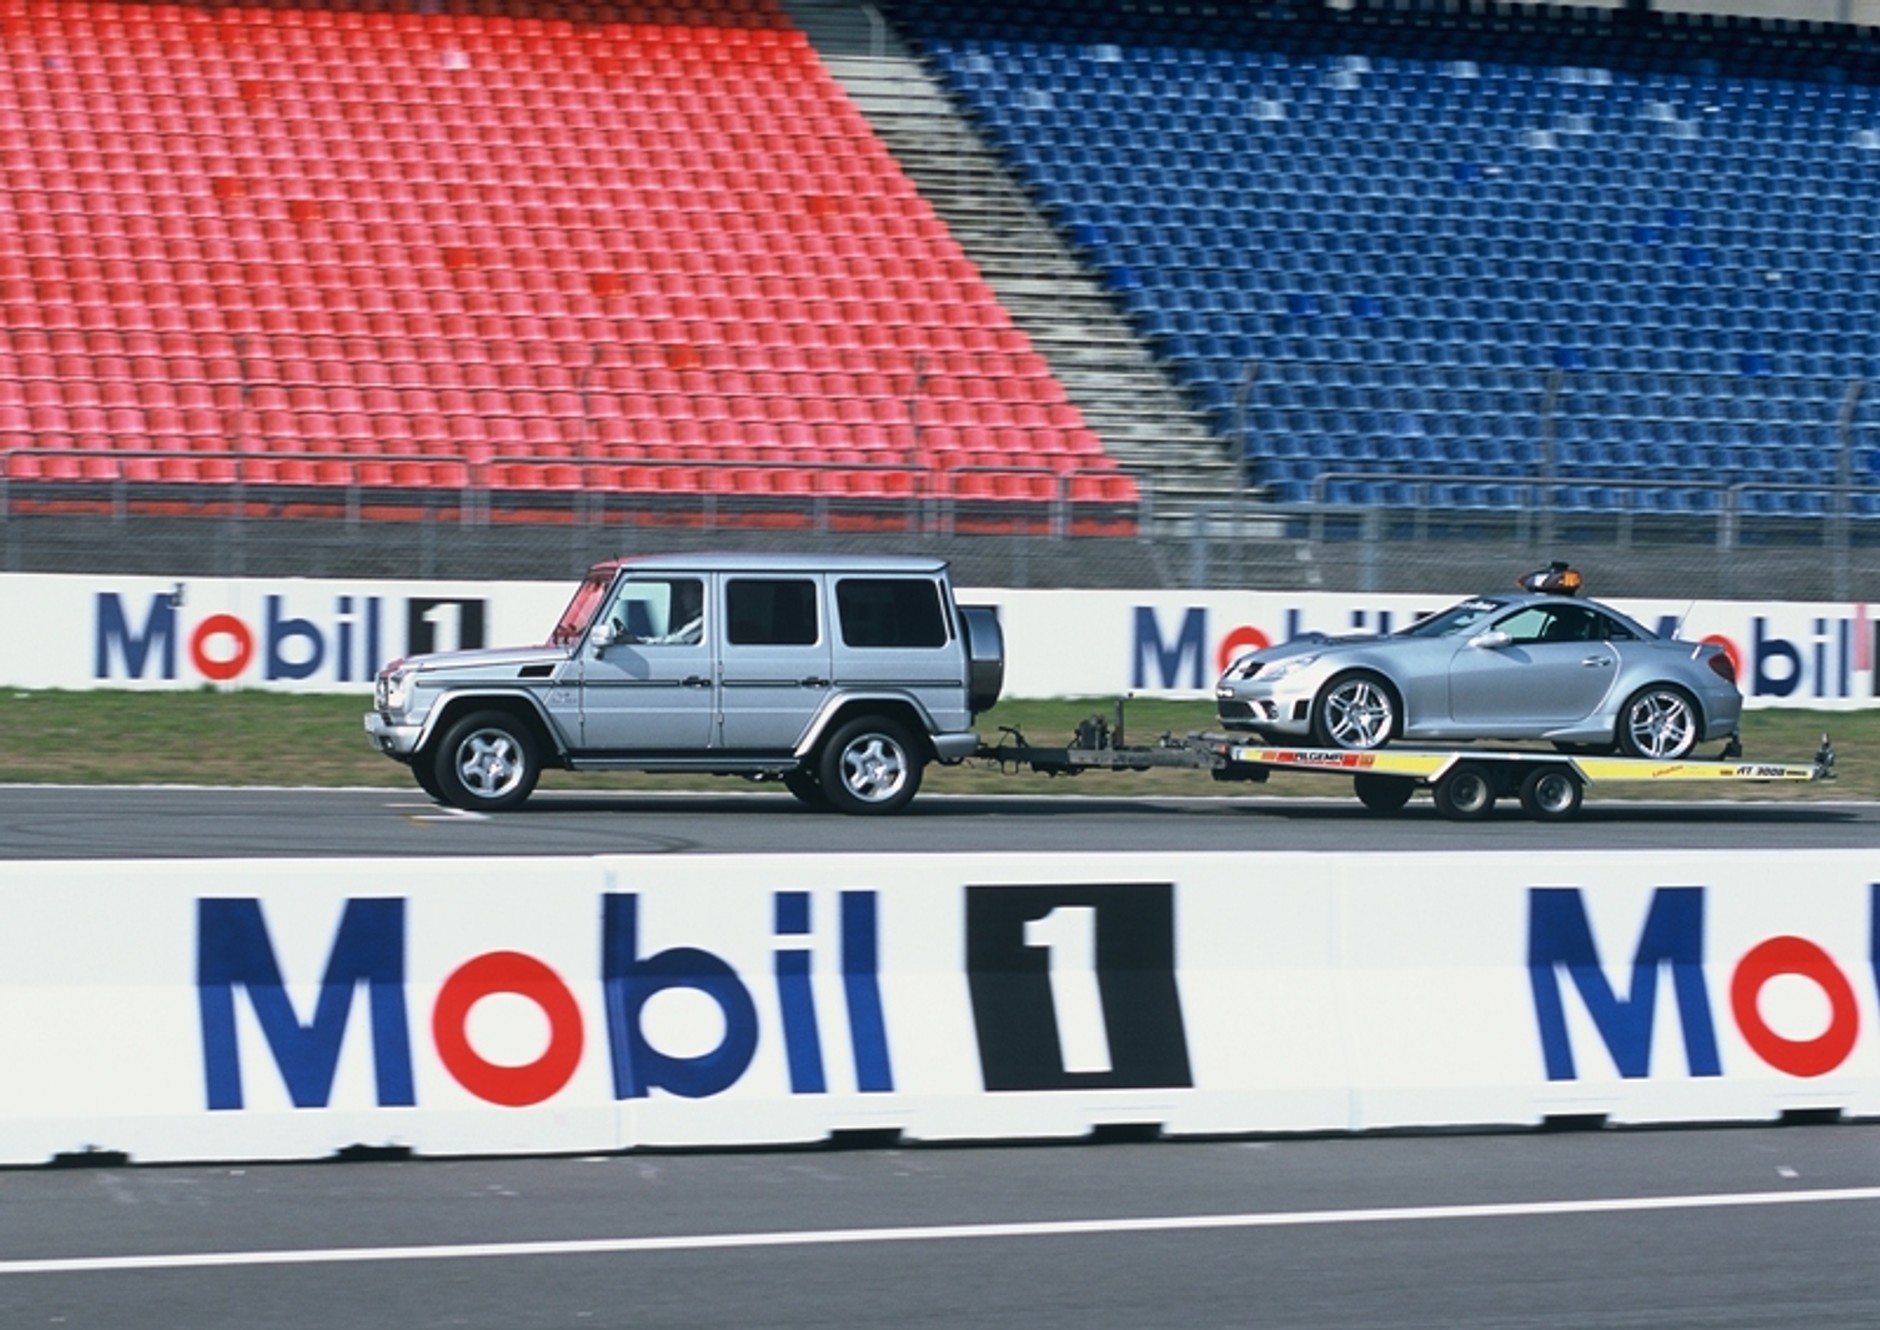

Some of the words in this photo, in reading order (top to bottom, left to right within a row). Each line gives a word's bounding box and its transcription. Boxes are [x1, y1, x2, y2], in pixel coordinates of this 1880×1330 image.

[94, 592, 381, 682] Mobil
[422, 603, 461, 652] 1
[197, 891, 893, 1109] Mobil
[1023, 906, 1113, 1073] 1
[1528, 883, 1880, 1081] Mo
